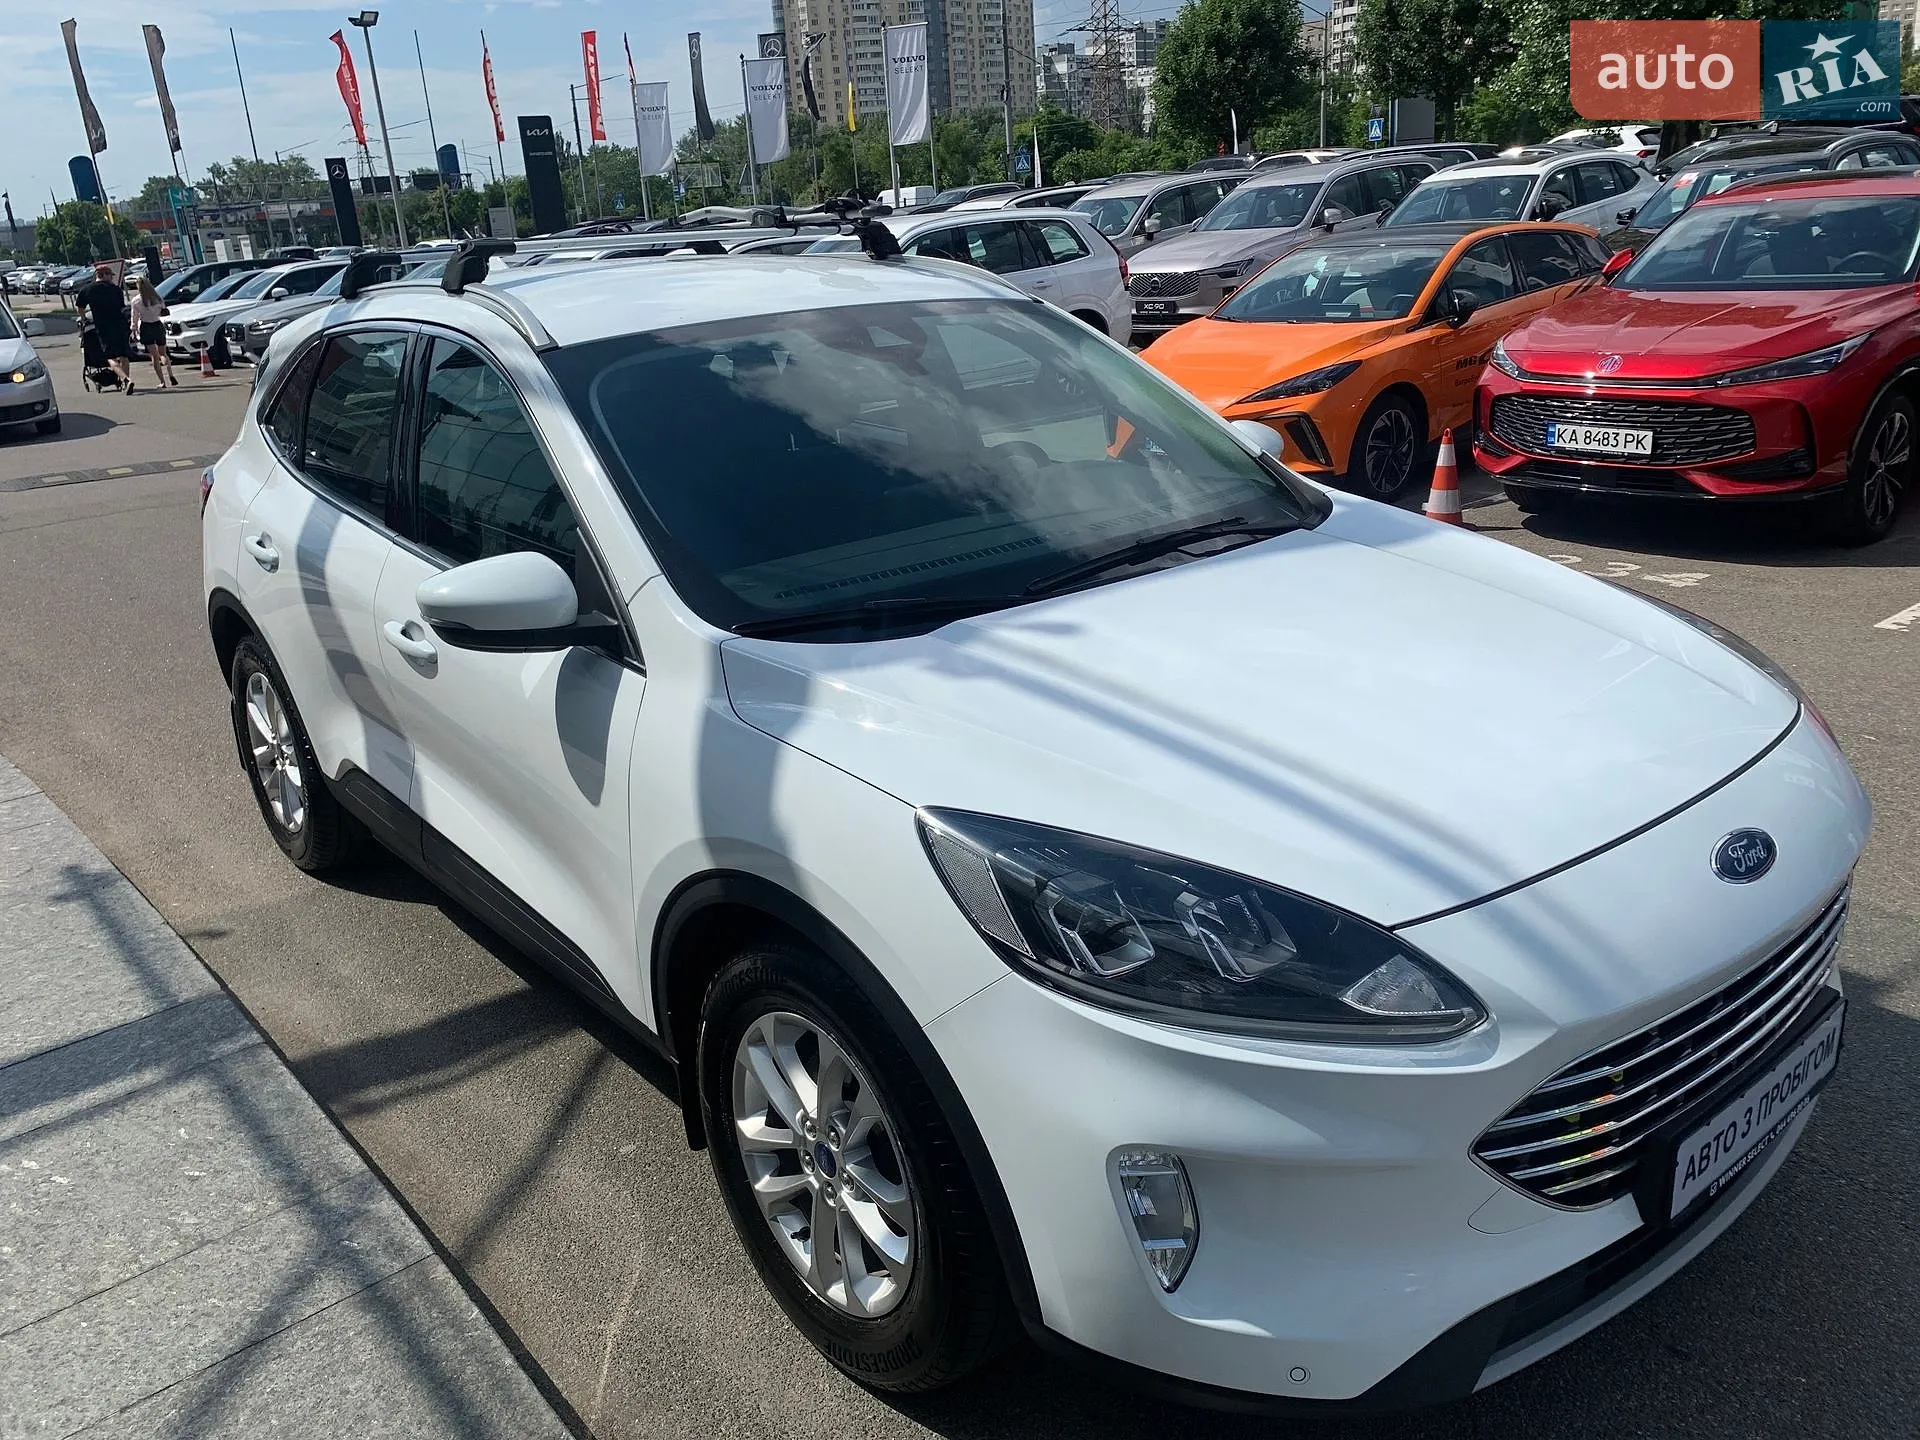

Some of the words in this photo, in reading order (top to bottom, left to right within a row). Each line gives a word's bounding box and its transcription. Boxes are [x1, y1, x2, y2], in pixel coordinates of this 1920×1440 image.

[891, 54, 926, 64] VOLVO
[894, 65, 923, 75] SELEKT
[751, 84, 783, 92] VOLVO
[640, 105, 667, 113] VOLVO
[526, 128, 549, 137] KIA
[1556, 427, 1579, 445] KA
[1583, 429, 1620, 448] 8483
[1623, 433, 1650, 451] PK
[1728, 838, 1767, 873] Ford
[1681, 1120, 1737, 1191] АВТО
[1756, 1027, 1837, 1127] ПРОБІГОМ
